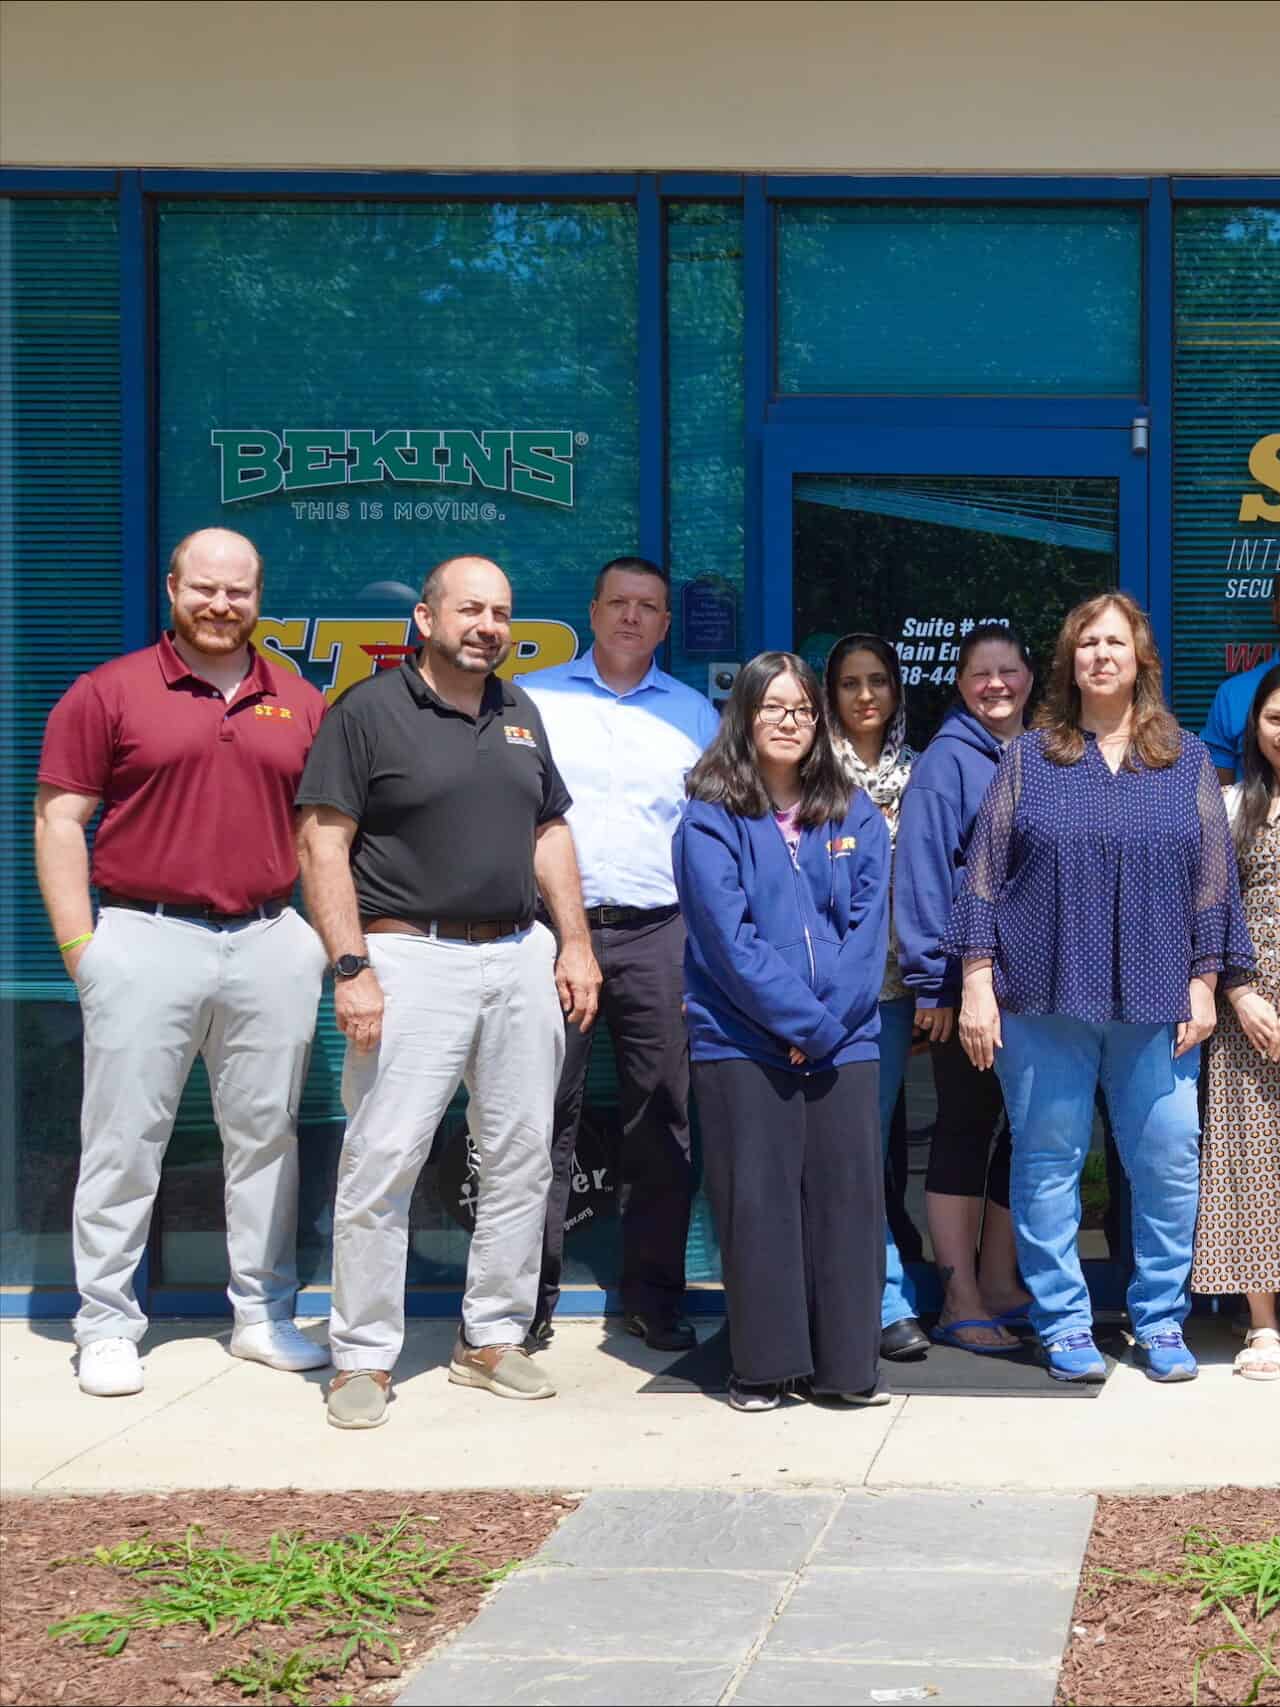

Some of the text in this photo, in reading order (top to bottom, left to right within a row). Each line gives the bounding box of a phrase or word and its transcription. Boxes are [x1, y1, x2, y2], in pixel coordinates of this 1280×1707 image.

[211, 429, 573, 506] BEKINS
[292, 502, 505, 520] THIS IS MOVING.
[1225, 579, 1274, 598] SECU
[902, 617, 955, 637] Suite
